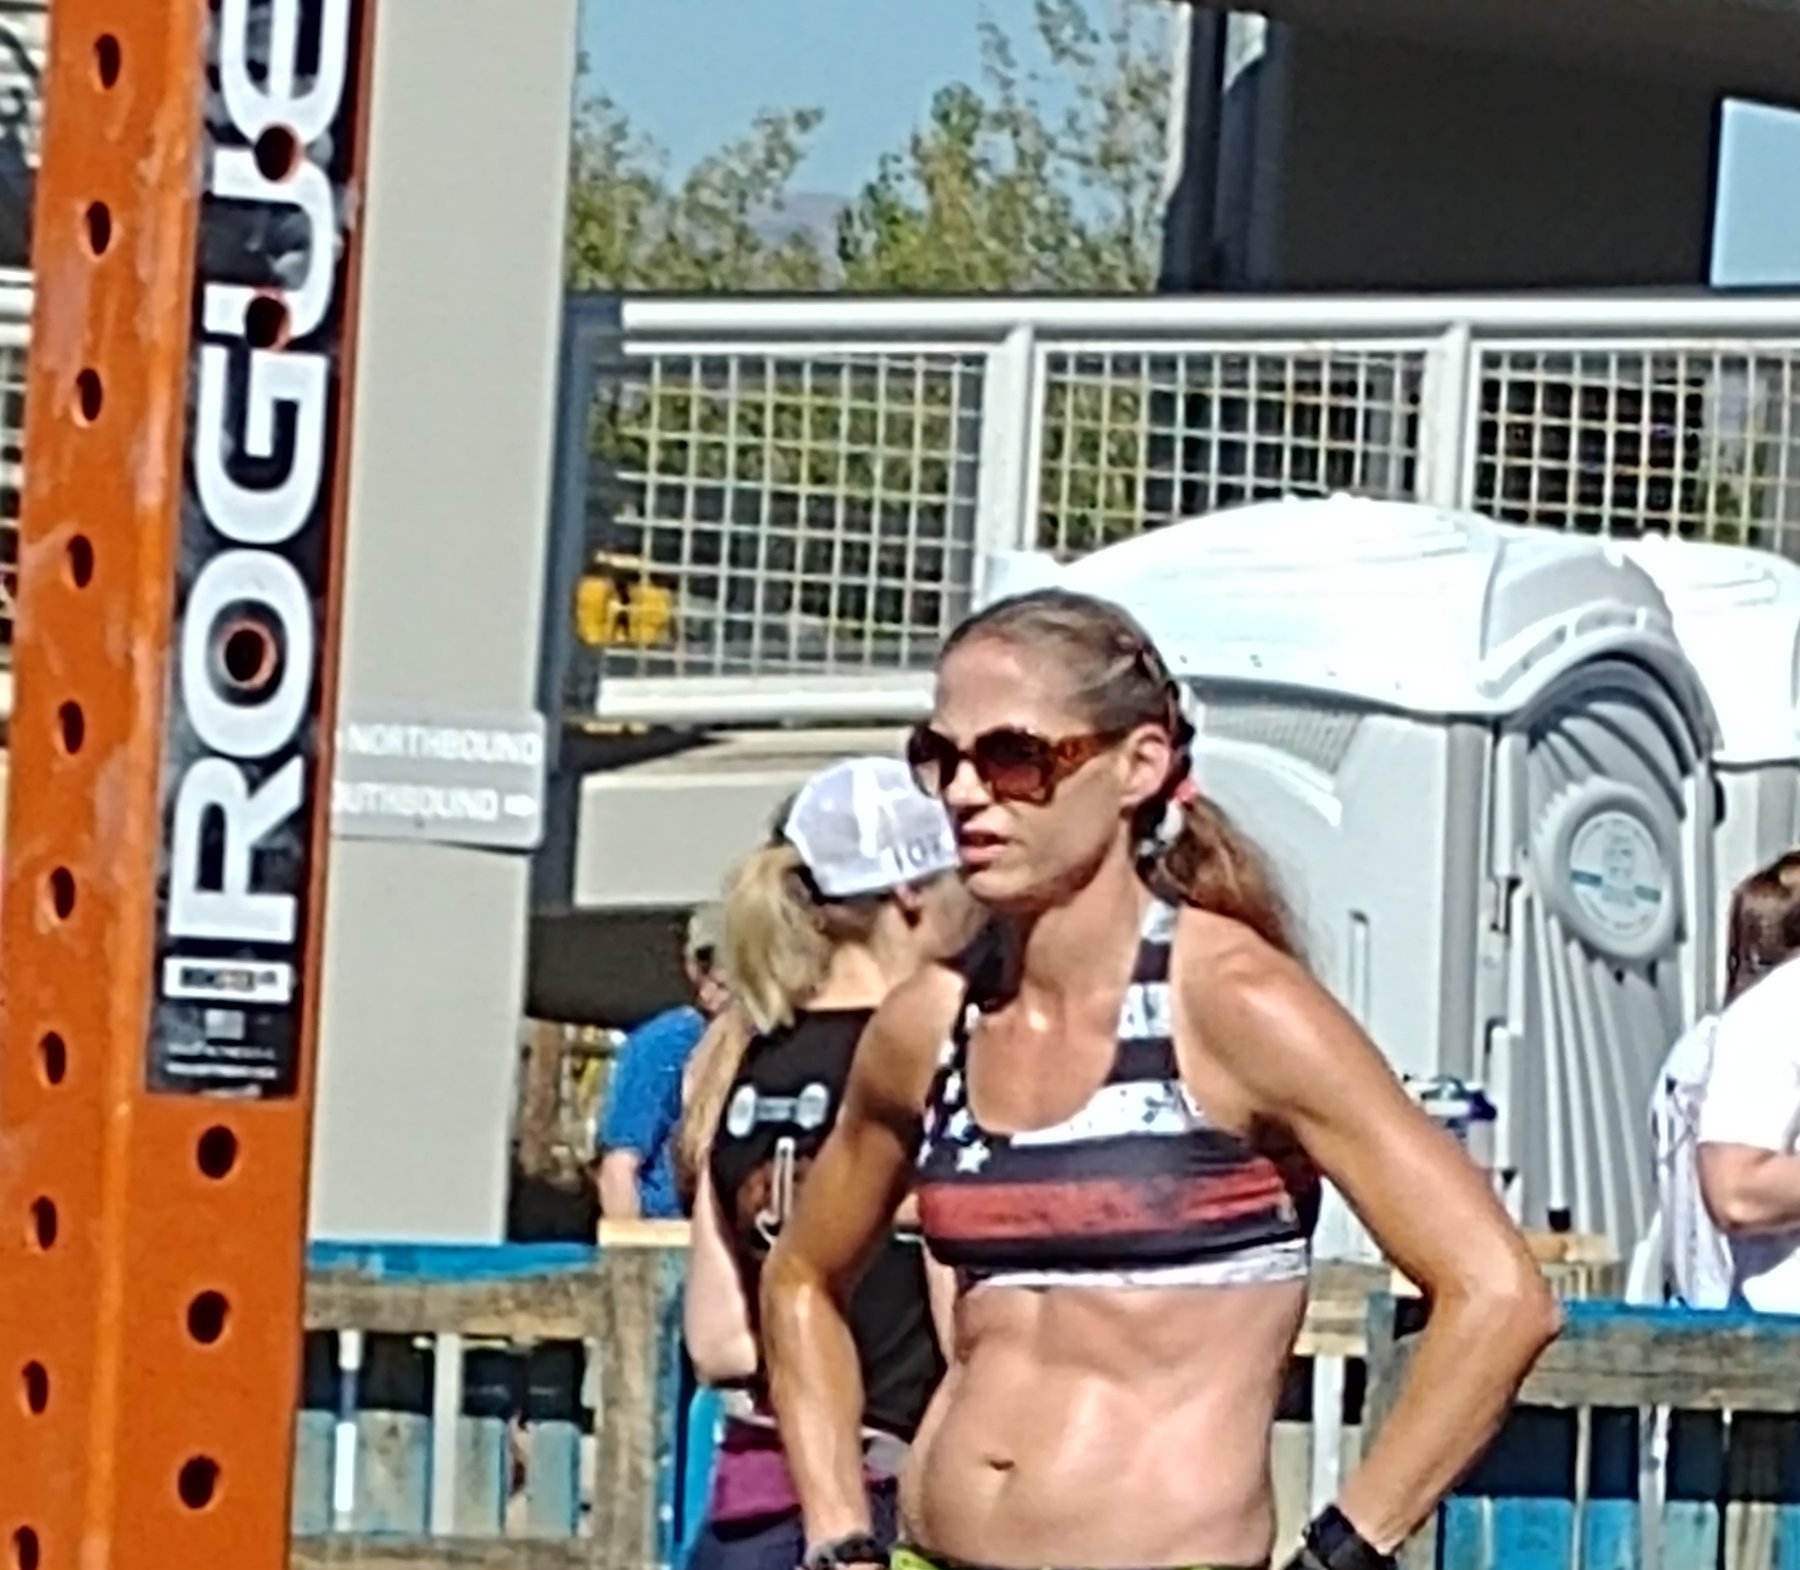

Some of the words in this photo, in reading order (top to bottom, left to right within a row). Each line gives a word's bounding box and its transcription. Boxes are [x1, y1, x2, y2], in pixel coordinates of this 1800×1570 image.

[168, 0, 350, 943] ROGUE
[349, 722, 544, 766] NORTHBOUND
[332, 779, 499, 823] OUTHBOUND
